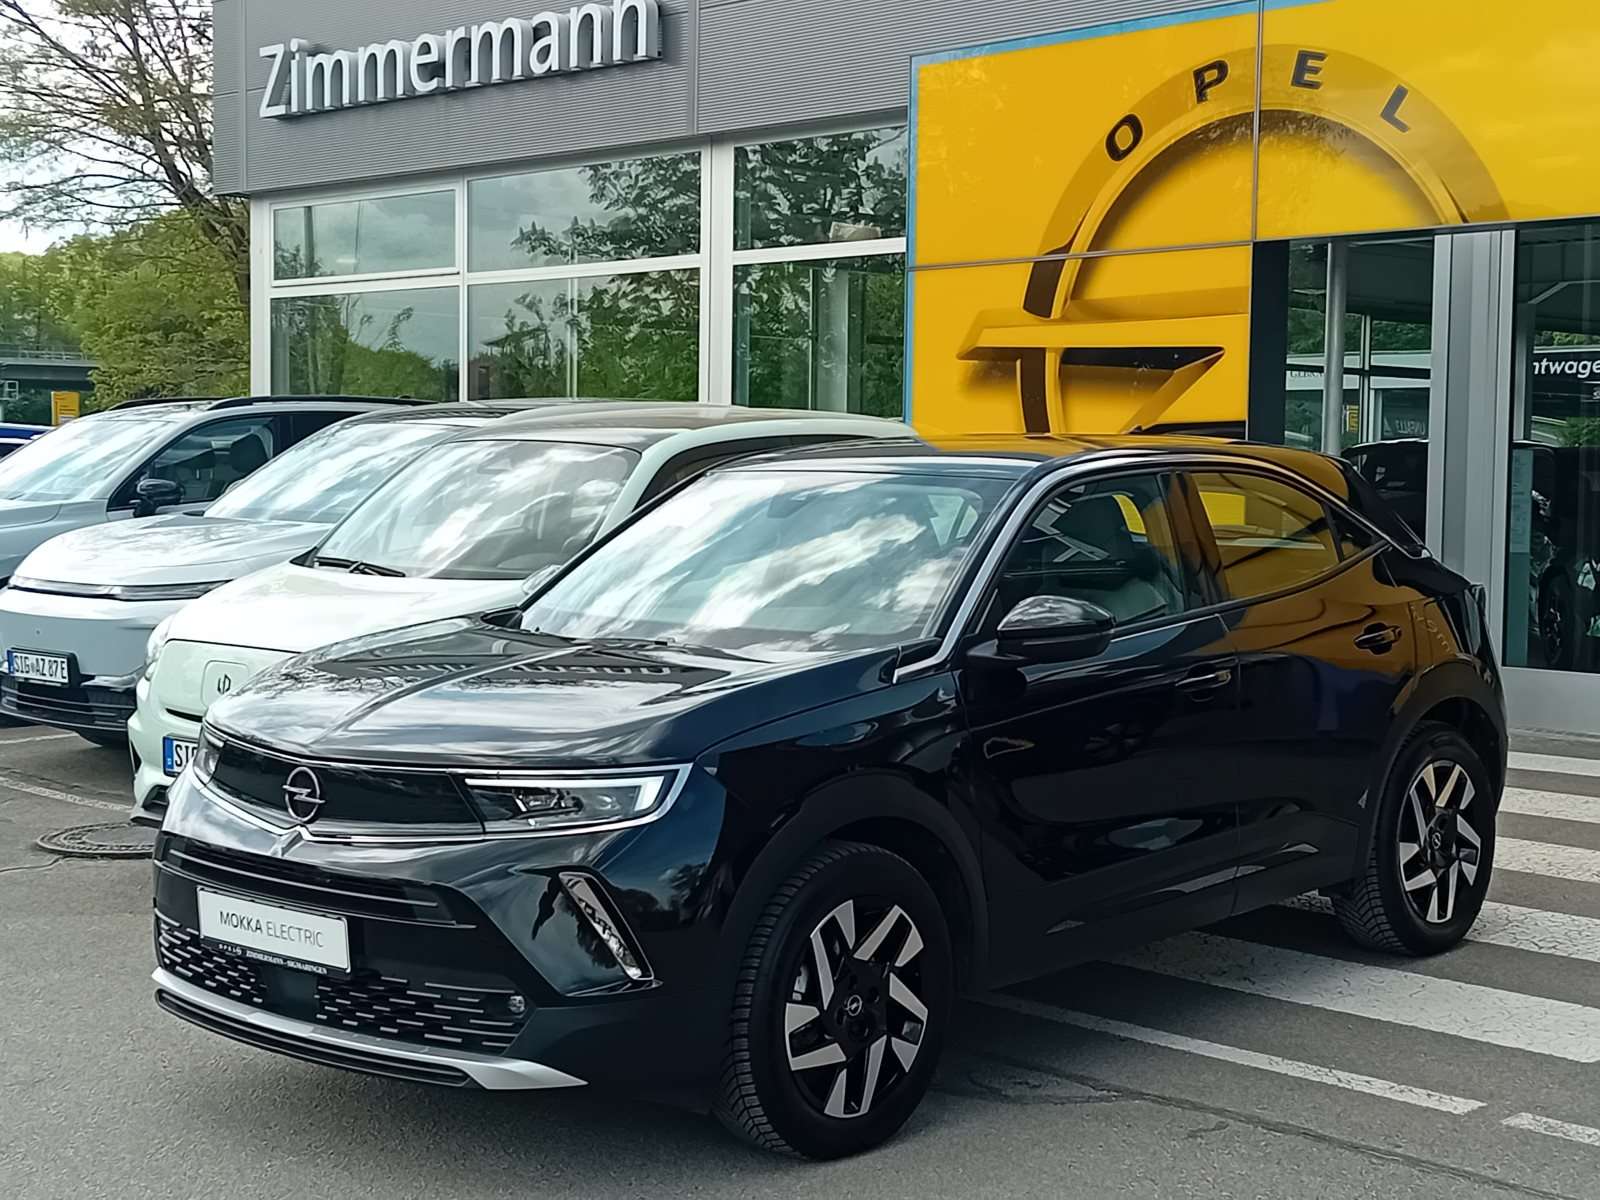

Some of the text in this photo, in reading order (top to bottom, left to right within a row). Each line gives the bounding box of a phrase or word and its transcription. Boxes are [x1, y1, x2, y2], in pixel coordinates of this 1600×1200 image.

[259, 0, 656, 118] Zimmermann
[1104, 49, 1410, 162] OPEL
[219, 910, 325, 949] MOKKA ELECTRIC
